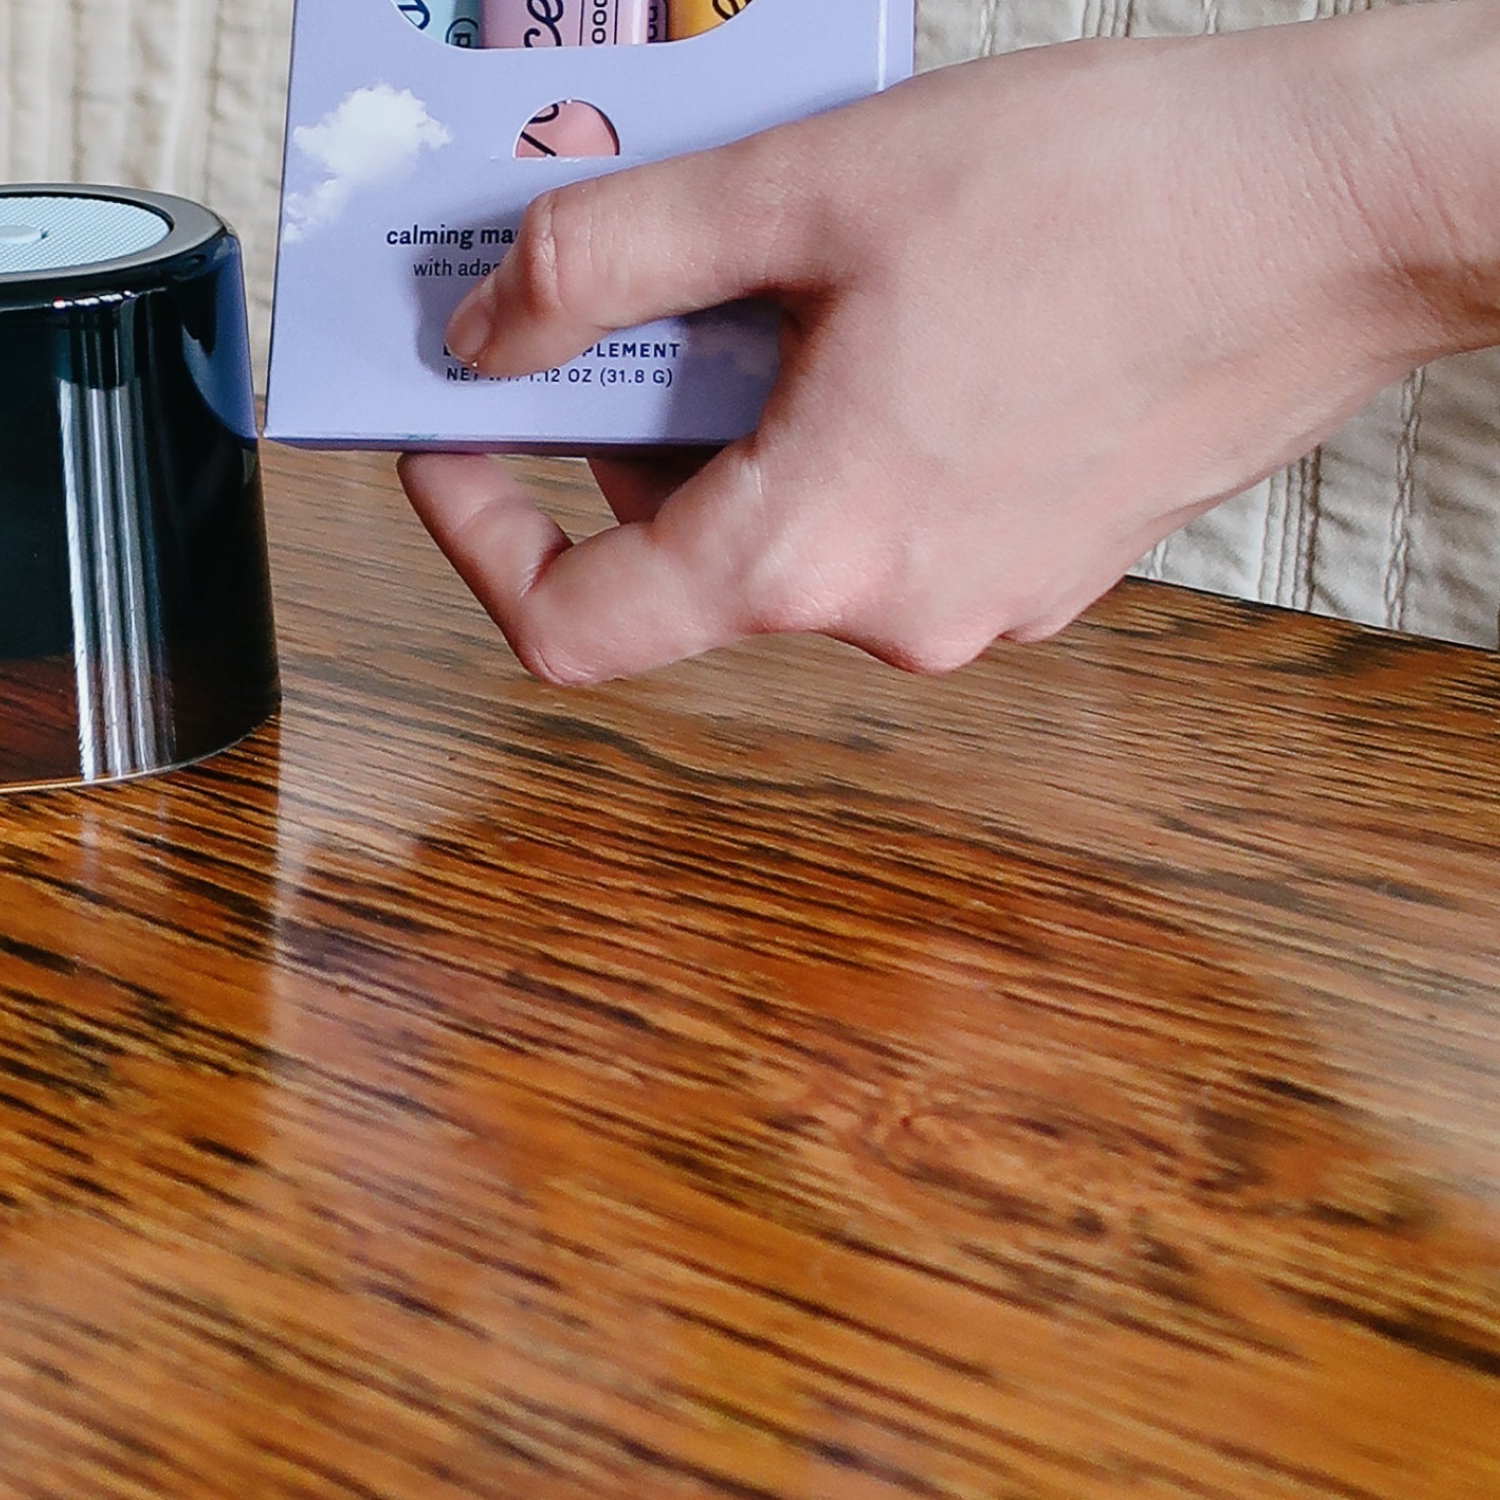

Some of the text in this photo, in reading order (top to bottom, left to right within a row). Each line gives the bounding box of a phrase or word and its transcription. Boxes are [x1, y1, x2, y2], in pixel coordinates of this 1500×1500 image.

[386, 223, 474, 250] calming
[412, 258, 453, 276] with
[582, 343, 680, 358] LEMENT
[567, 368, 593, 383] OZ
[600, 367, 645, 387] (31.8
[652, 367, 673, 388] G)
